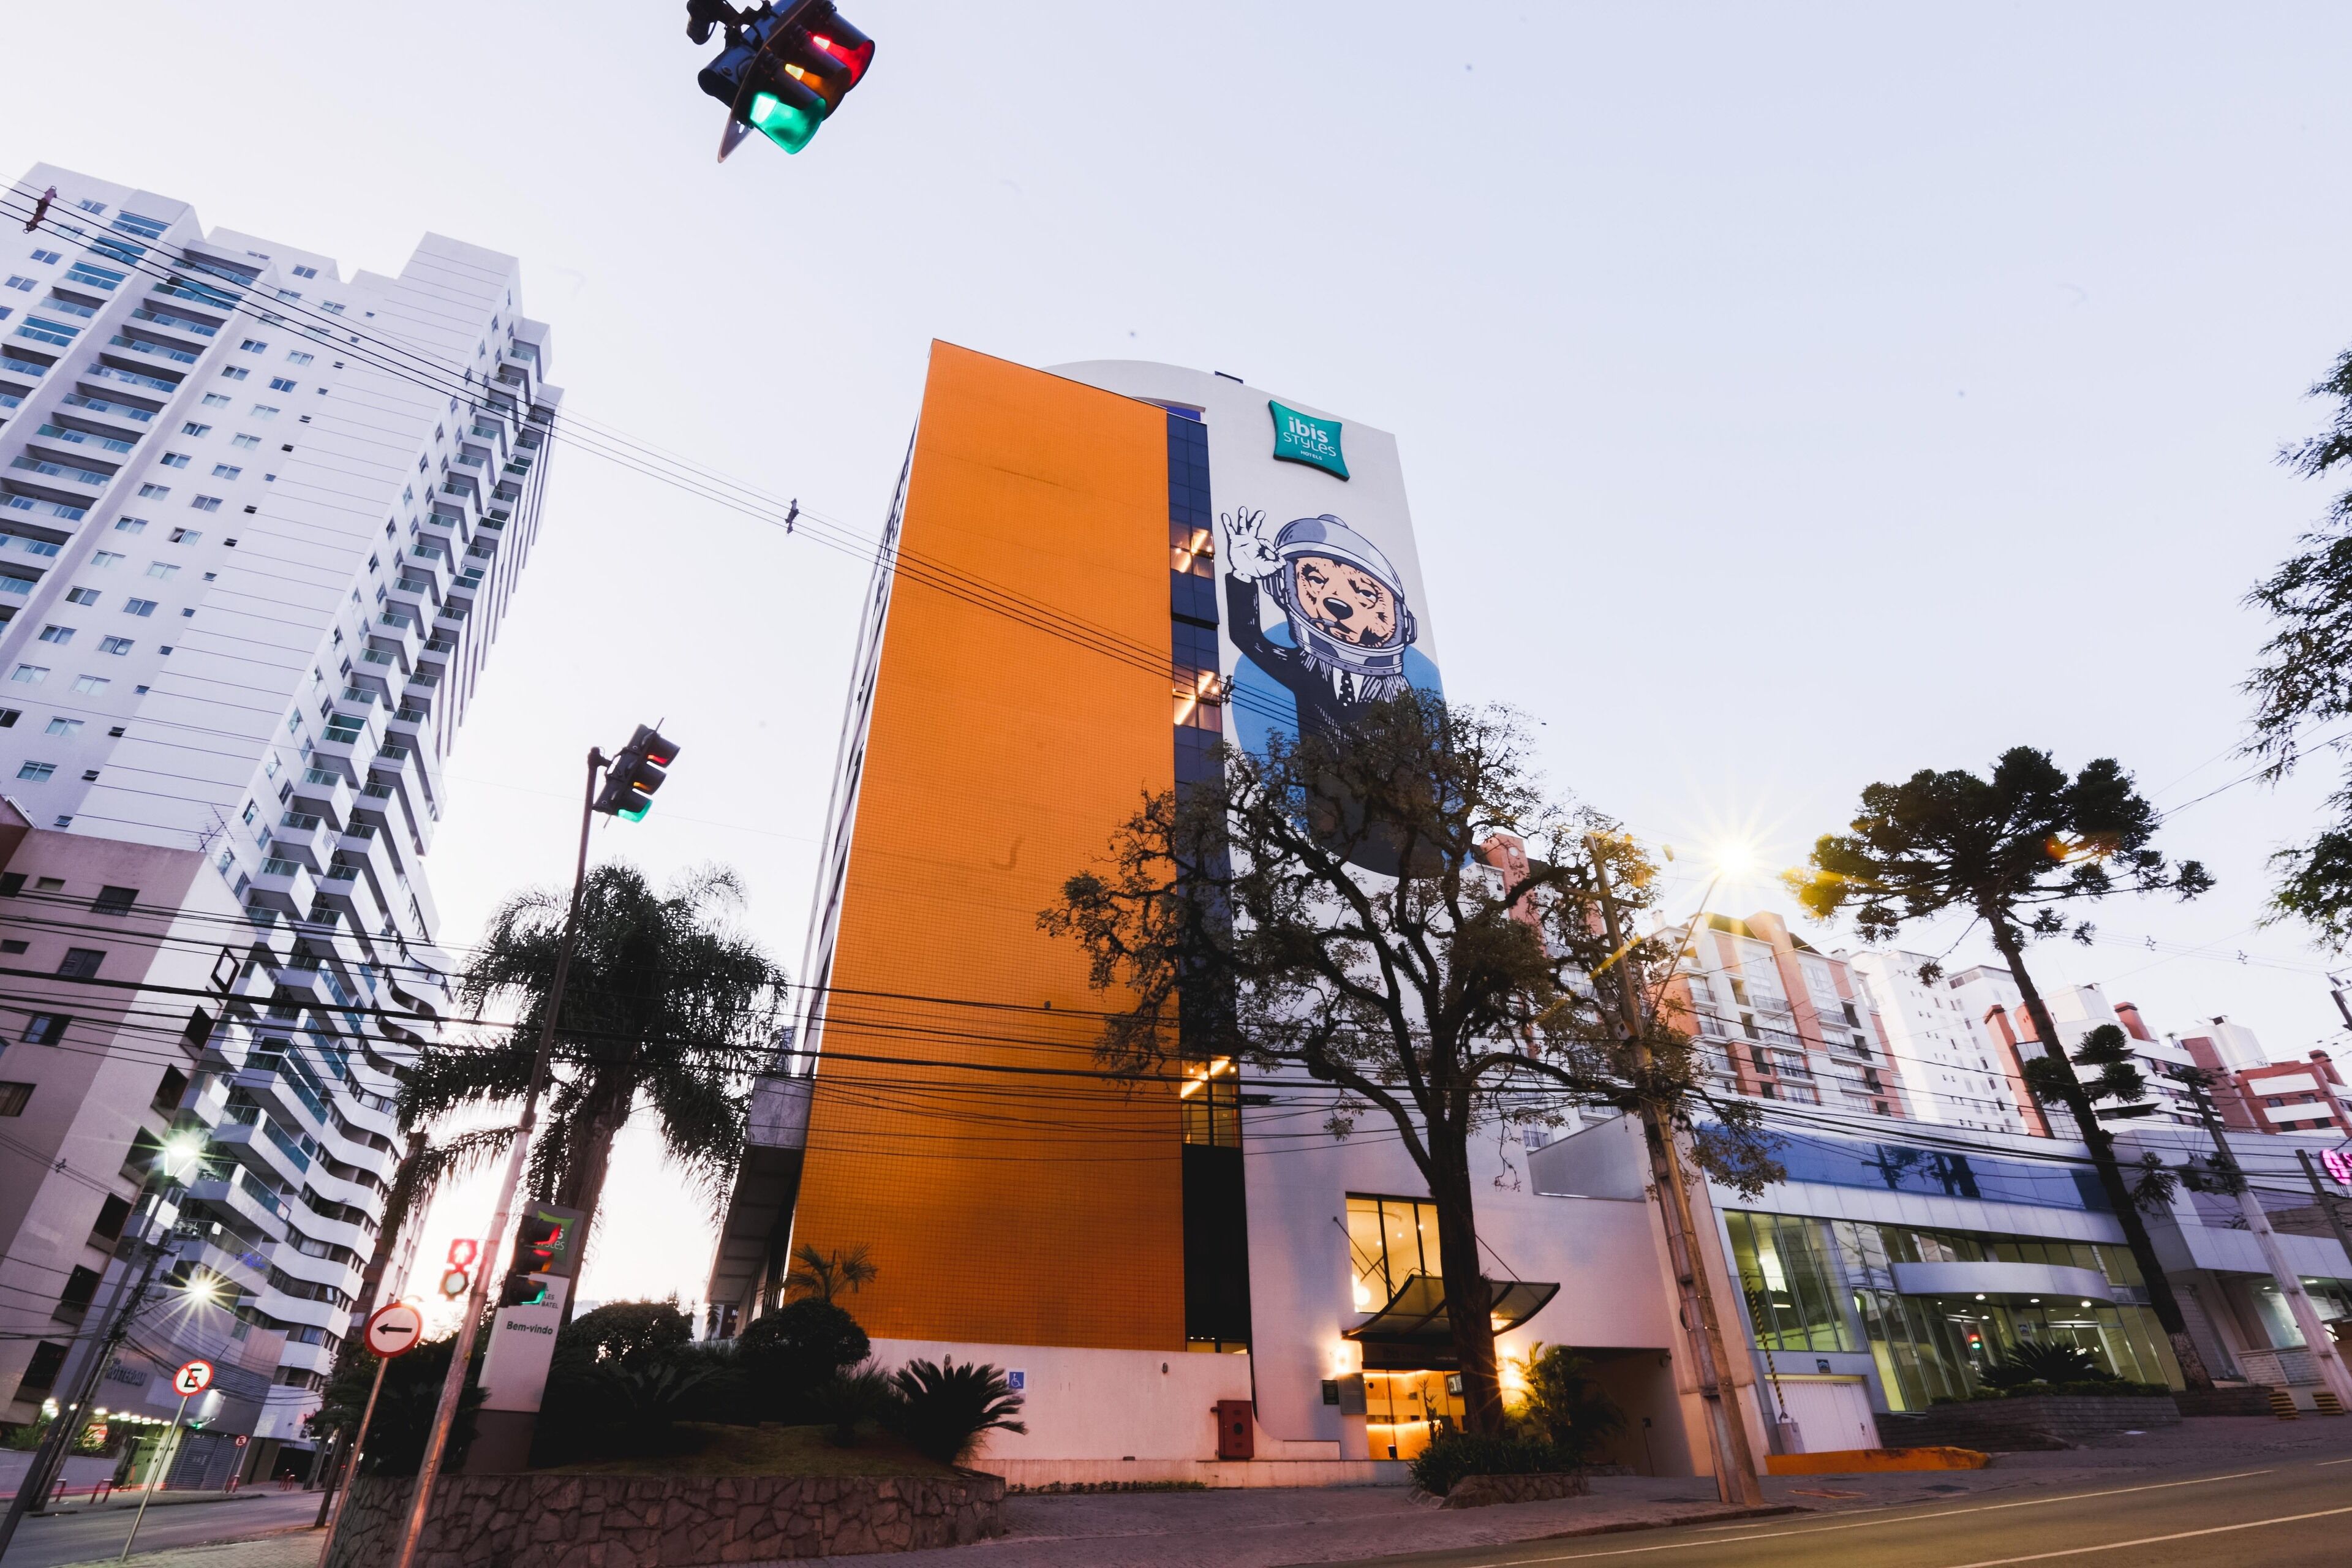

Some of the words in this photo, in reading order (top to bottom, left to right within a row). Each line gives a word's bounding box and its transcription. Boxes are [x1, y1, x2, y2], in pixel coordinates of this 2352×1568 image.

[1288, 416, 1329, 443] ibis
[1300, 450, 1322, 461] HOTELS
[506, 1321, 554, 1335] Bem-vindo
[184, 1368, 203, 1387] E
